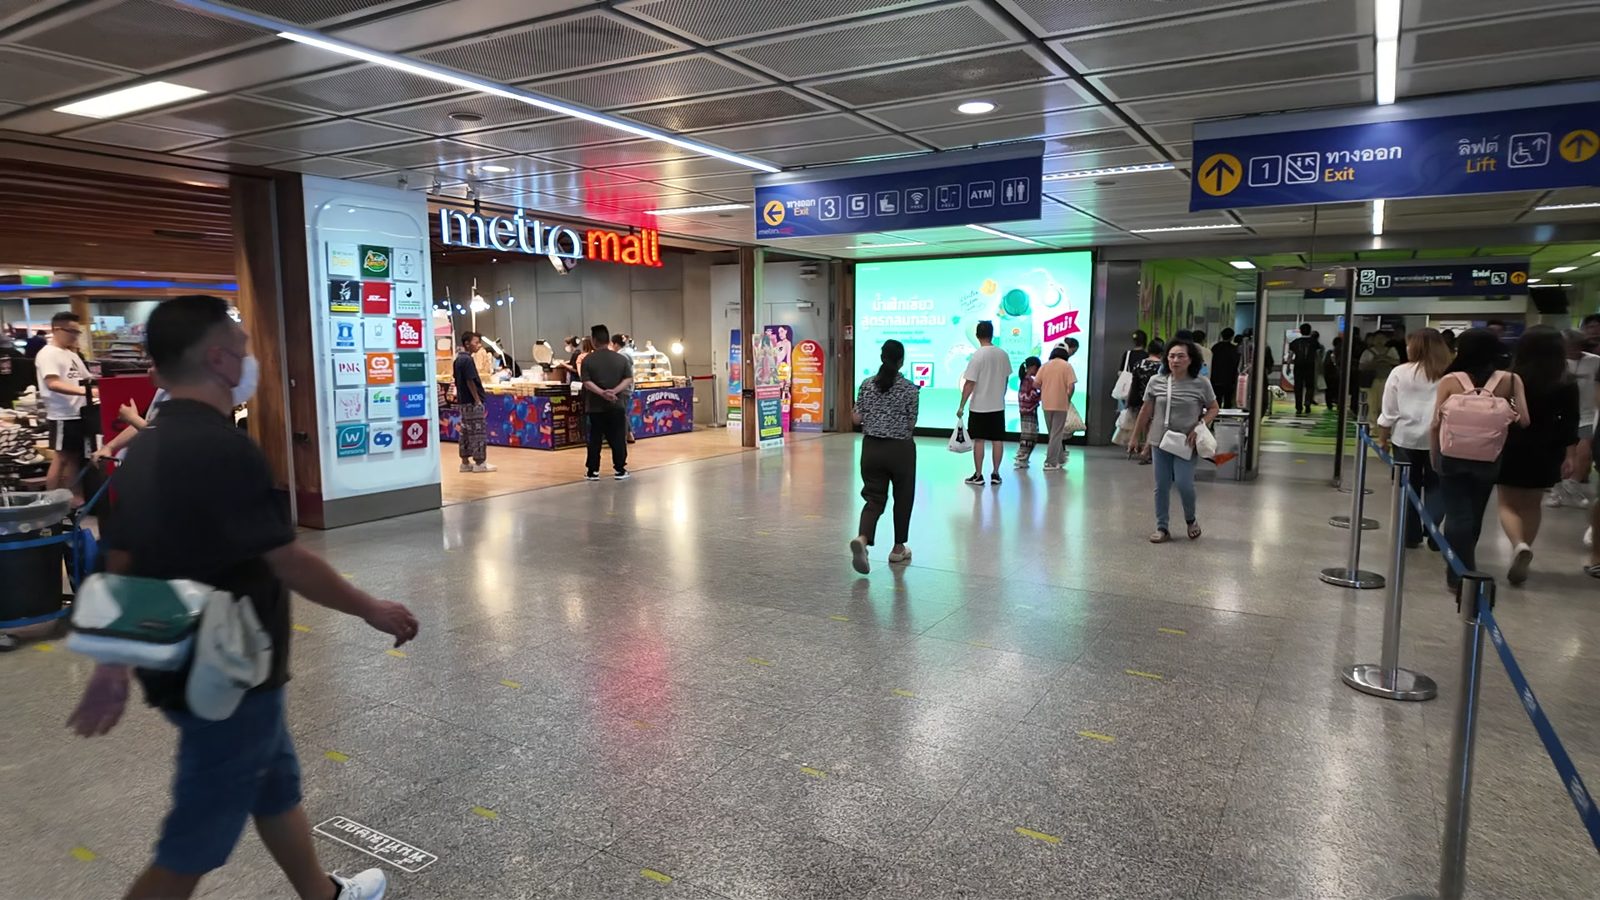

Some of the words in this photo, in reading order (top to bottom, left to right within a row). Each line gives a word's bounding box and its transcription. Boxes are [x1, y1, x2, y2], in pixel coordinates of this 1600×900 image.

[1458, 134, 1501, 156] ลิฟต์
[1325, 146, 1402, 165] ทางออก
[1261, 162, 1269, 180] 1
[1324, 166, 1355, 182] Exit
[1466, 156, 1497, 174] Lift
[970, 189, 992, 200] ATM
[786, 199, 816, 209] ทางออก
[794, 207, 809, 217] Exit
[824, 199, 836, 217] 3
[439, 208, 584, 259] metro
[586, 228, 663, 267] mall
[1047, 316, 1073, 337] ใหม่!
